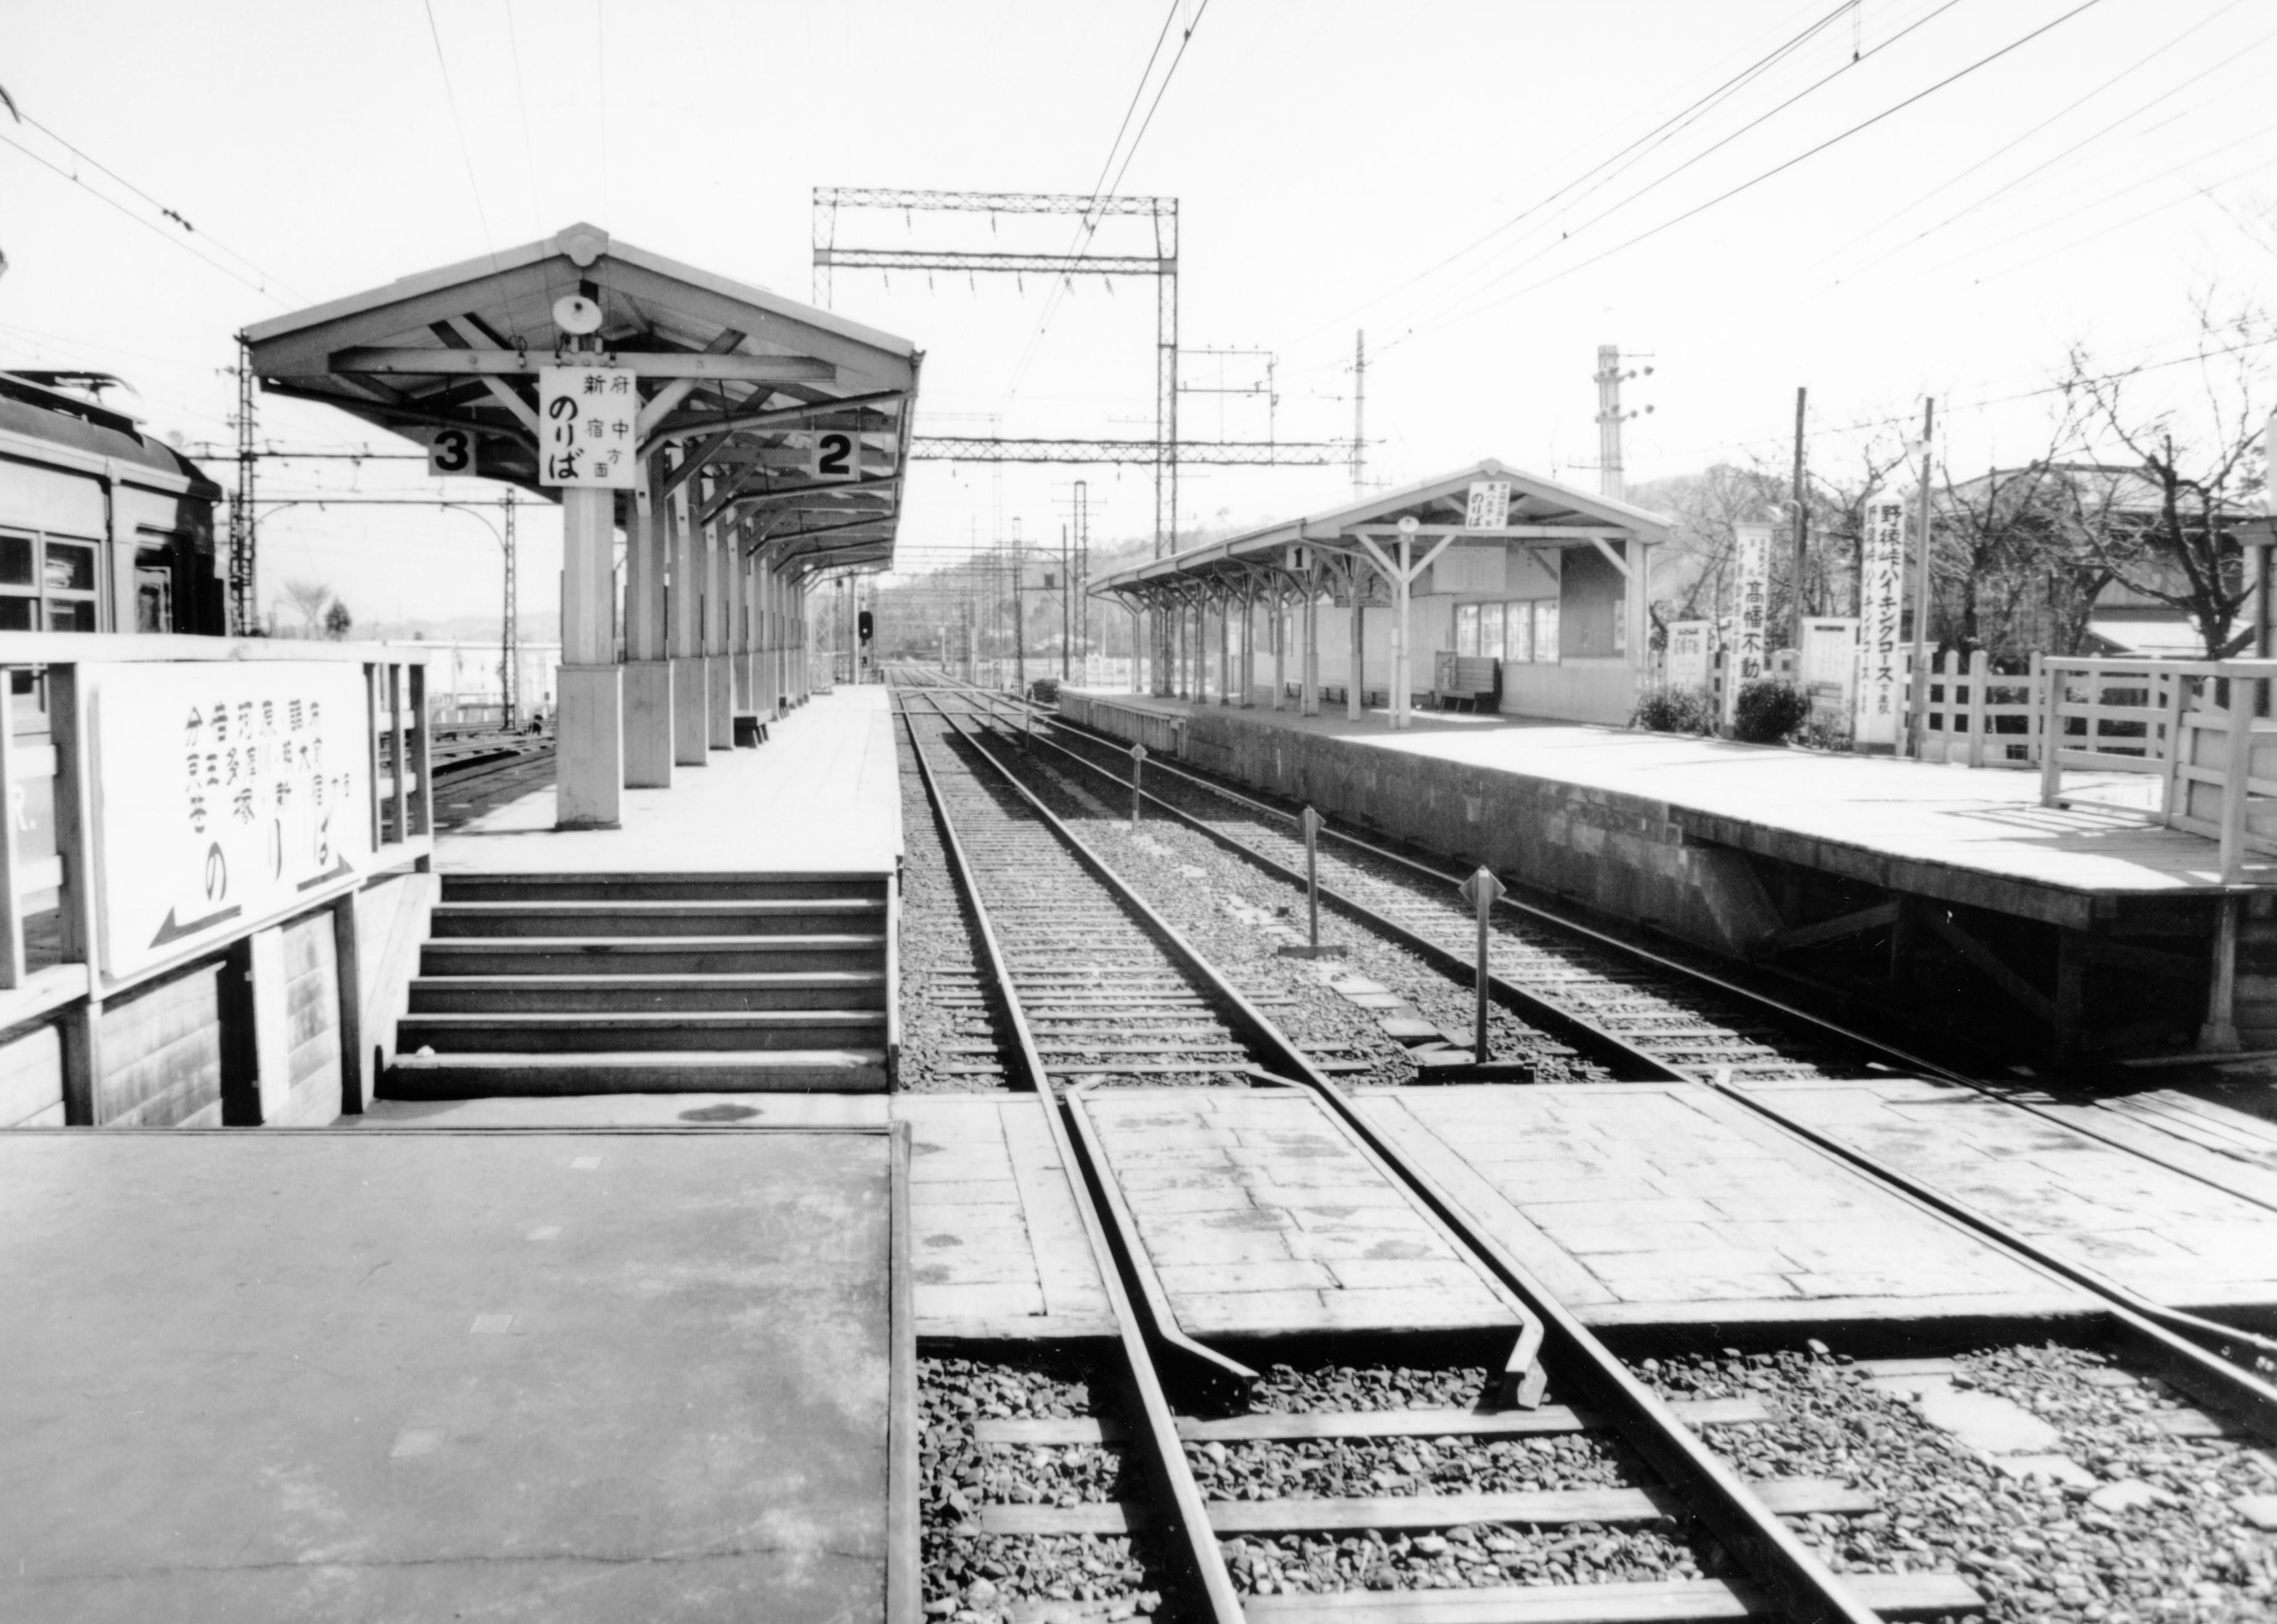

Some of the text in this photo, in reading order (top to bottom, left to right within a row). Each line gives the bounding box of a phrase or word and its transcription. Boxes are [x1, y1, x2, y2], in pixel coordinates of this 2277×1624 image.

[584, 375, 606, 438] 新宿
[611, 376, 630, 439] 府中
[435, 430, 469, 471] 3
[549, 396, 584, 479] のりば
[819, 434, 853, 475] 2
[1468, 492, 1484, 528] のりば
[1295, 547, 1303, 568] 1
[205, 803, 333, 901] のりば
